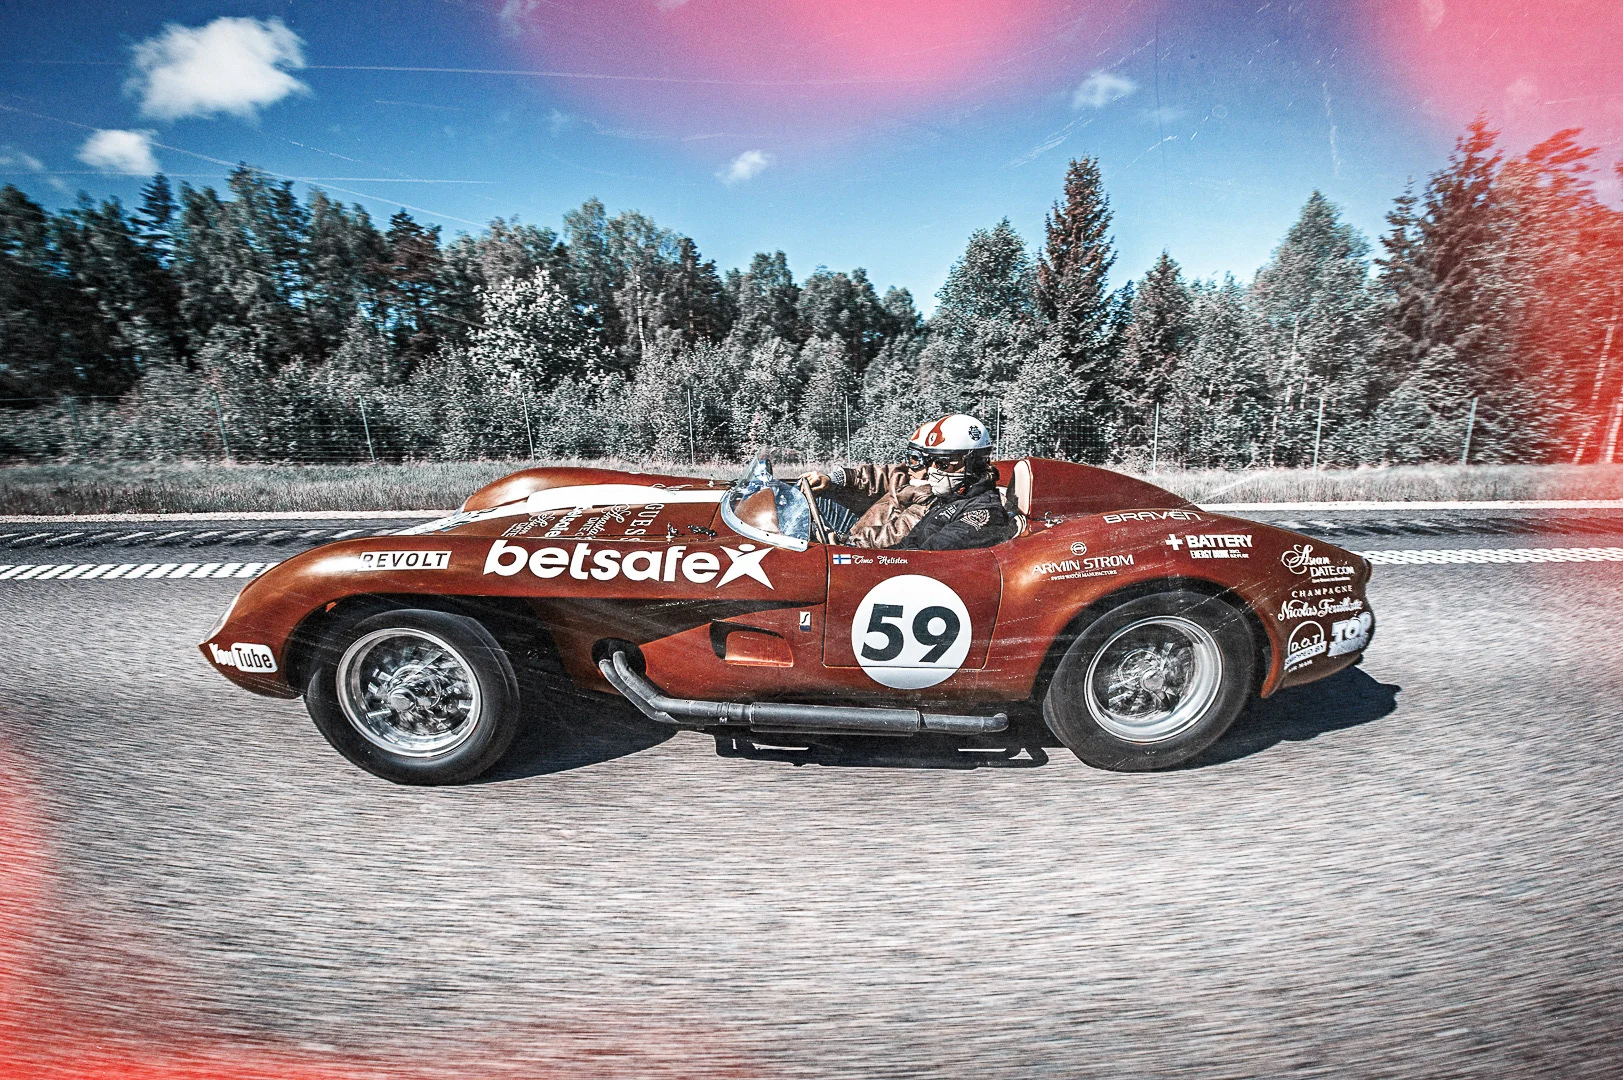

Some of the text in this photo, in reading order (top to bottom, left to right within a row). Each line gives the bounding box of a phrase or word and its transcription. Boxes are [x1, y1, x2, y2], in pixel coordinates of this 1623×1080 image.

[1103, 511, 1201, 524] BRAVEN
[1185, 535, 1253, 548] BATTERY
[483, 540, 720, 583] betsafe
[1032, 554, 1135, 575] ARMIN STROM
[1291, 585, 1353, 598] CHAMPAGNE
[1278, 600, 1318, 621] Nicolas
[861, 603, 961, 663] 59
